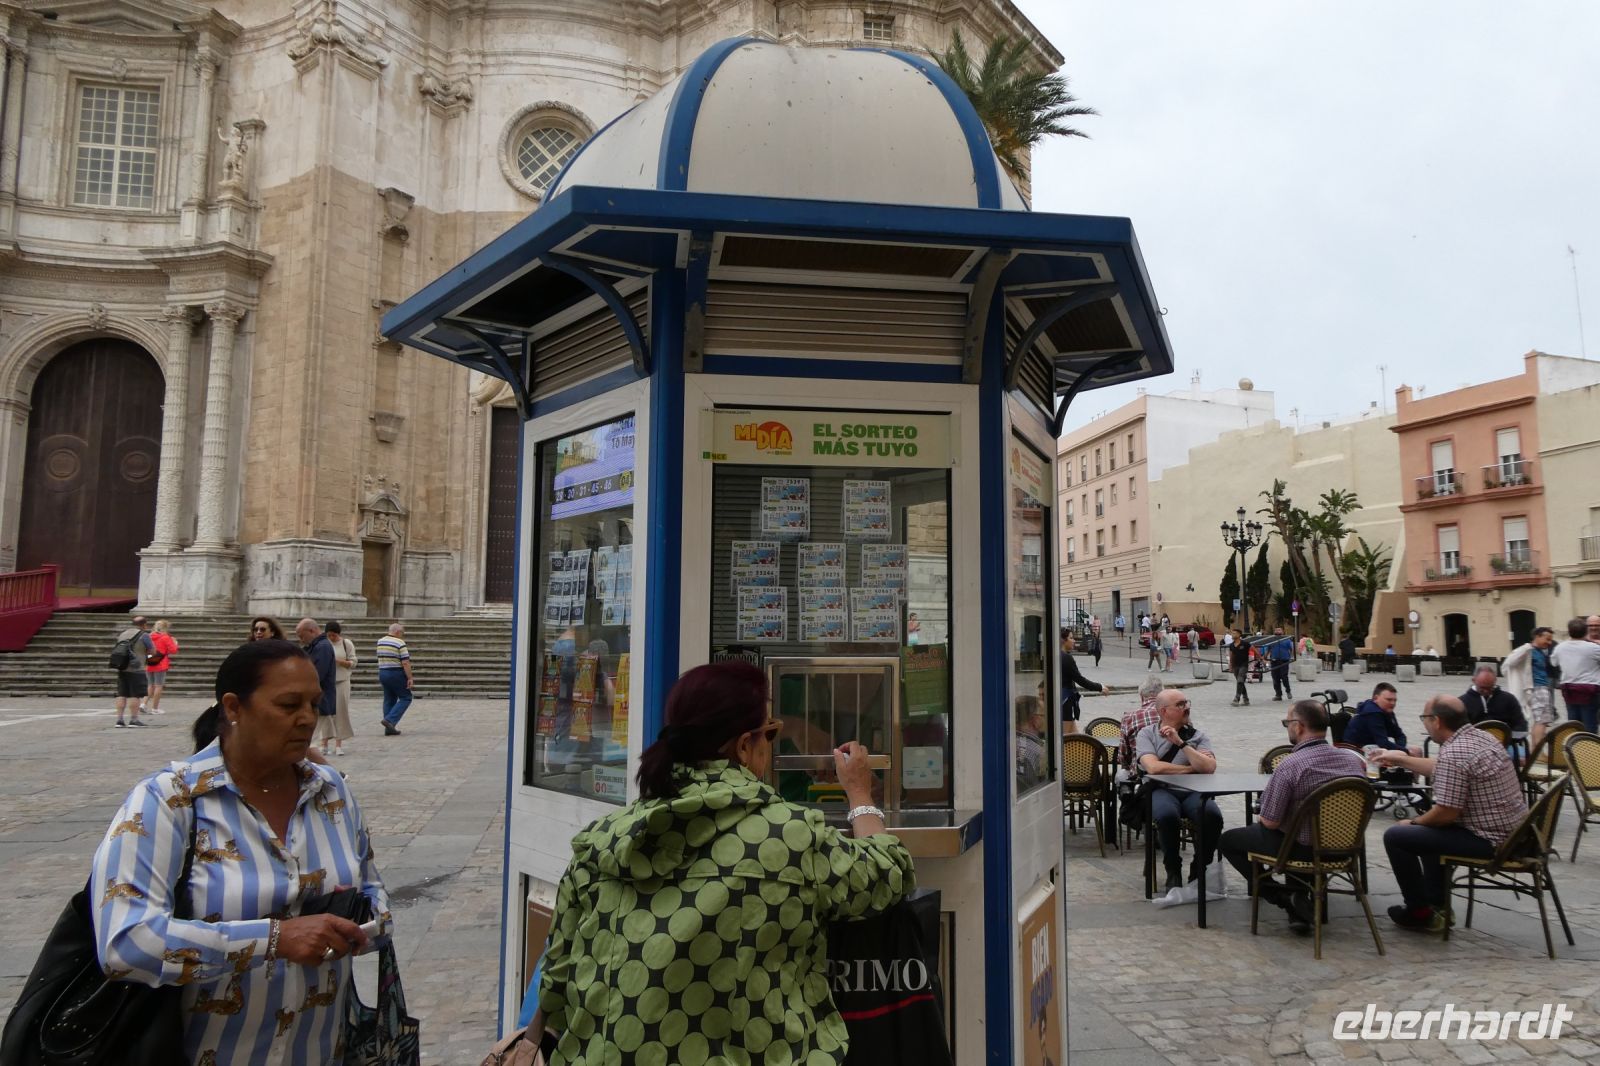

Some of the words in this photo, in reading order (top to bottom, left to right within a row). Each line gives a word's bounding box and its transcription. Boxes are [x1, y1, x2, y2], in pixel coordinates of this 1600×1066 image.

[735, 424, 757, 441] MI
[756, 427, 793, 450] DÍA
[813, 423, 837, 437] EL
[841, 424, 918, 439] SORTEO
[813, 438, 860, 456] MÁS
[863, 442, 918, 457] TUYO
